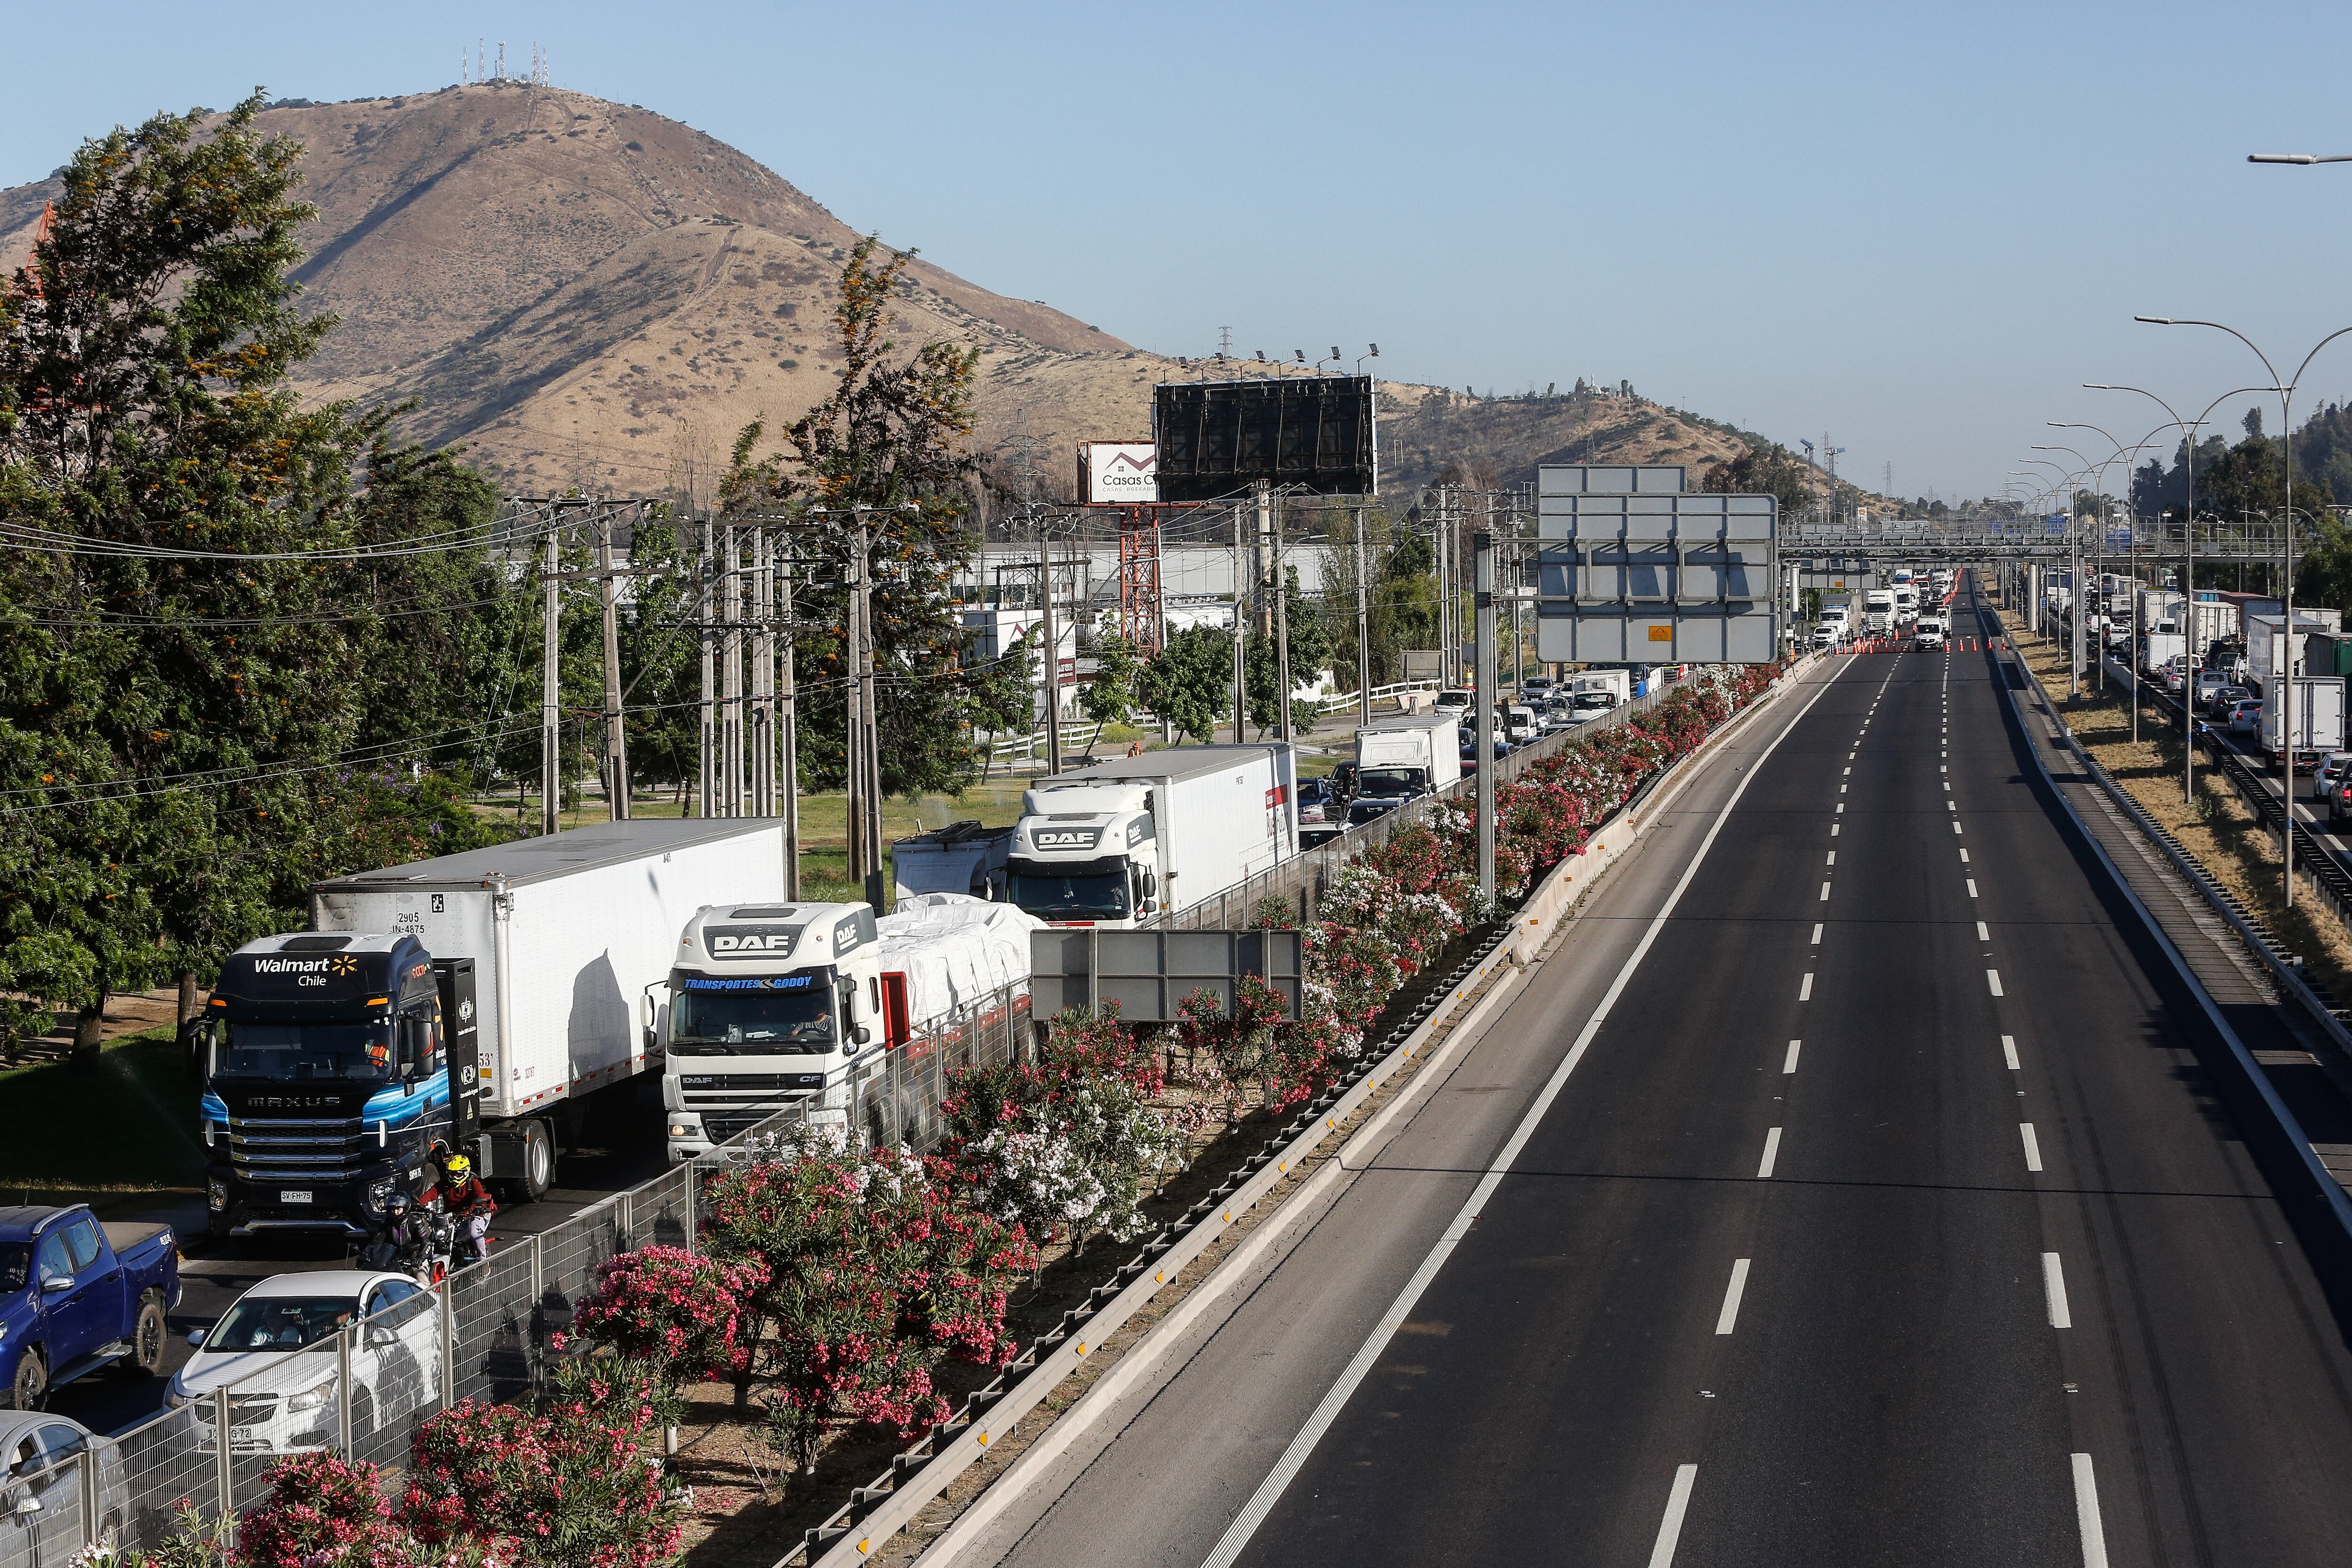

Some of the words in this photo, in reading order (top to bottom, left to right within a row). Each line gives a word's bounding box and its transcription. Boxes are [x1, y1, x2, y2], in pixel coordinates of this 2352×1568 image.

[1103, 475, 1142, 485] Casas
[1039, 832, 1095, 844] DAF
[1128, 824, 1141, 840] DAF
[398, 912, 419, 923] 2905
[836, 923, 857, 945] DAF
[714, 935, 789, 950] DAF
[254, 958, 330, 973] Walmart
[298, 975, 327, 986] Chile
[684, 979, 761, 990] TRANSPORTES
[773, 976, 813, 988] GODOY
[248, 1097, 340, 1107] MAXUS
